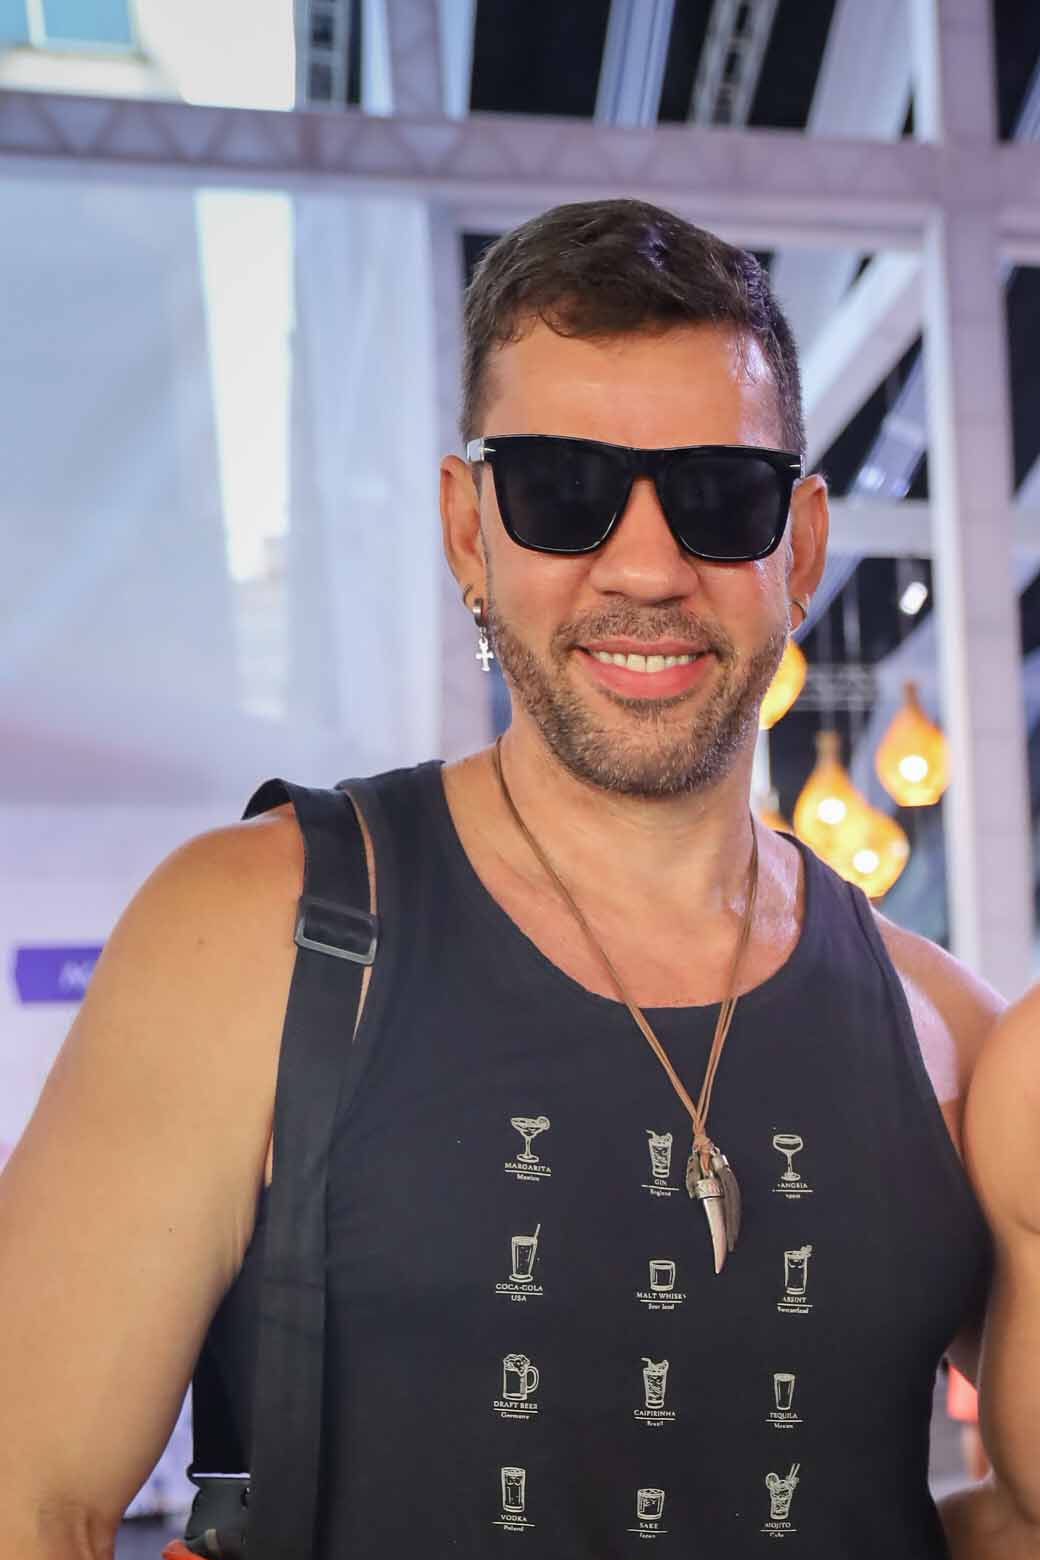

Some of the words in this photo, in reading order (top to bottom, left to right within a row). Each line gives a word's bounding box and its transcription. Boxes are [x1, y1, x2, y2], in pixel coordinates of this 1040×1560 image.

[504, 1162, 552, 1173] MARGARITA
[654, 1178, 667, 1186] GIN
[495, 1283, 544, 1292] COCA-COLA
[511, 1294, 527, 1302] USA
[493, 1400, 519, 1409] DRAFT
[633, 1409, 676, 1418] CAIPIRINHA
[769, 1412, 798, 1420] TEQUILA
[500, 1514, 527, 1522] VODKA
